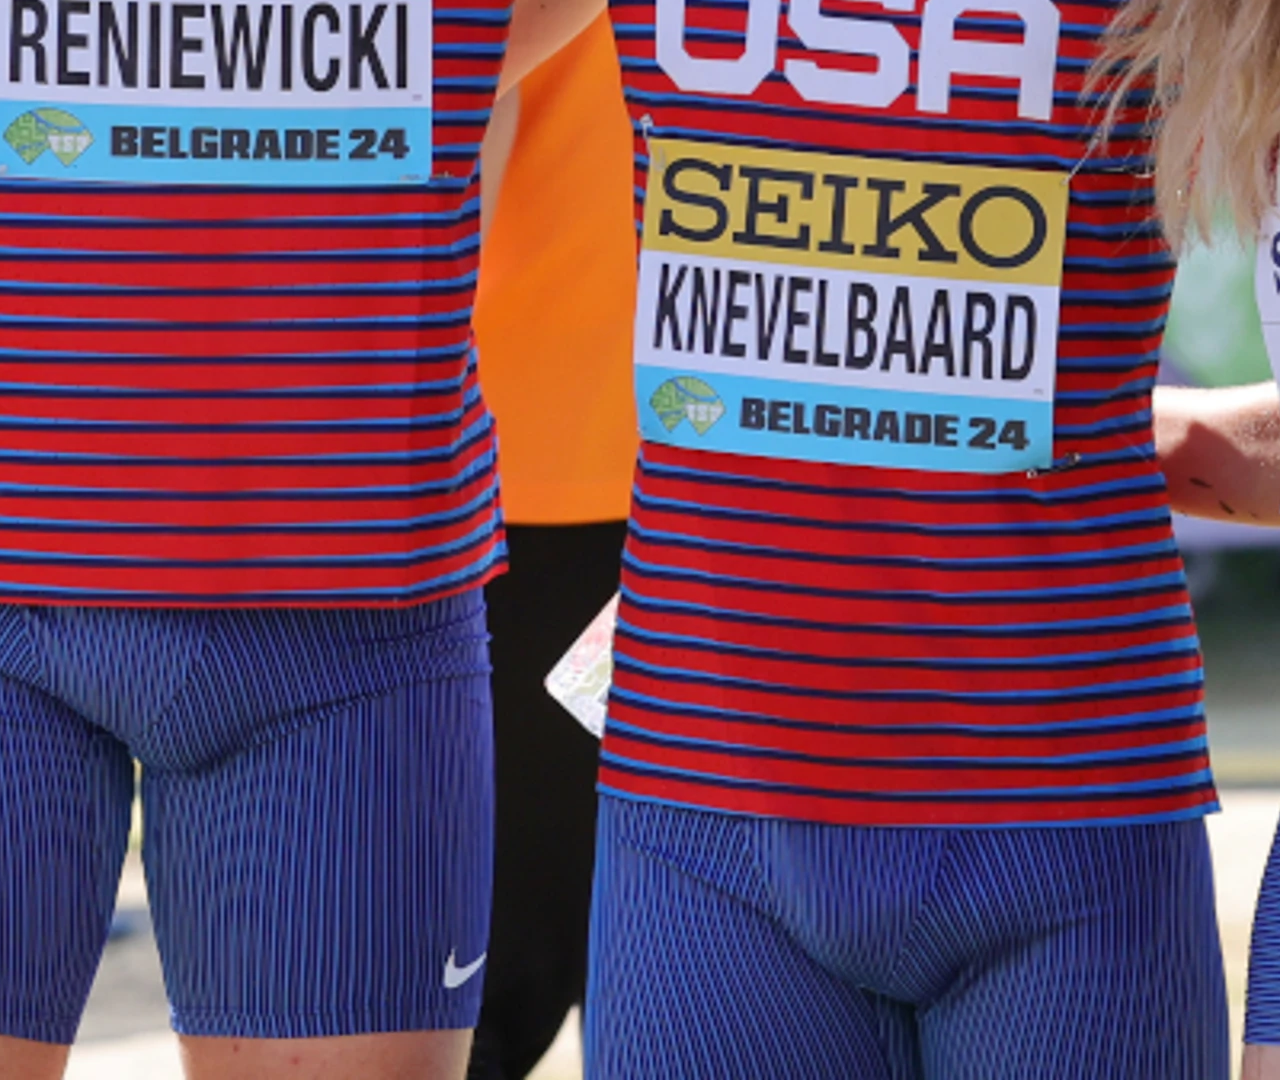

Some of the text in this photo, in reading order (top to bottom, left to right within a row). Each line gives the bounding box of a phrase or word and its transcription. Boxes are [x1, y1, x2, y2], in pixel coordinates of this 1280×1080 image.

[110, 125, 410, 161] BELGRADE 24
[658, 157, 1048, 269] SEIKO
[652, 262, 1037, 382] KNEVELBAARD
[738, 395, 1030, 451] BELGRADE 24
